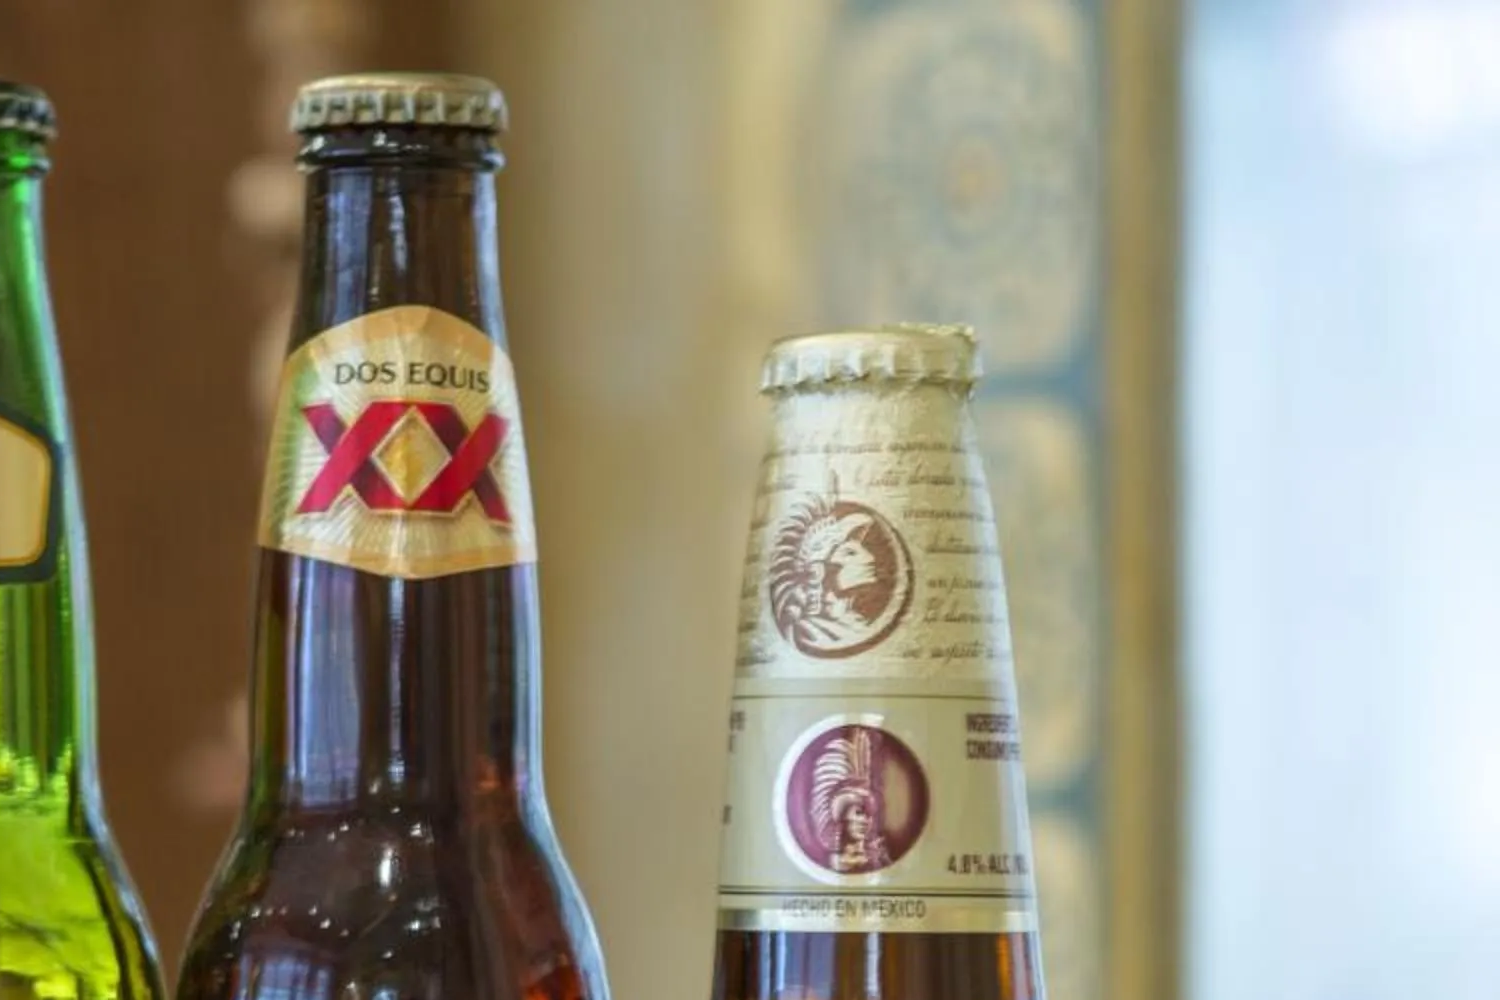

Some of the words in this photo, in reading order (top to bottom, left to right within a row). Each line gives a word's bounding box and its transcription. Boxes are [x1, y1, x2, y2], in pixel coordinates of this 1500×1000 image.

[334, 362, 396, 385] DOS
[406, 362, 491, 393] EQUIS
[835, 898, 858, 918] EN
